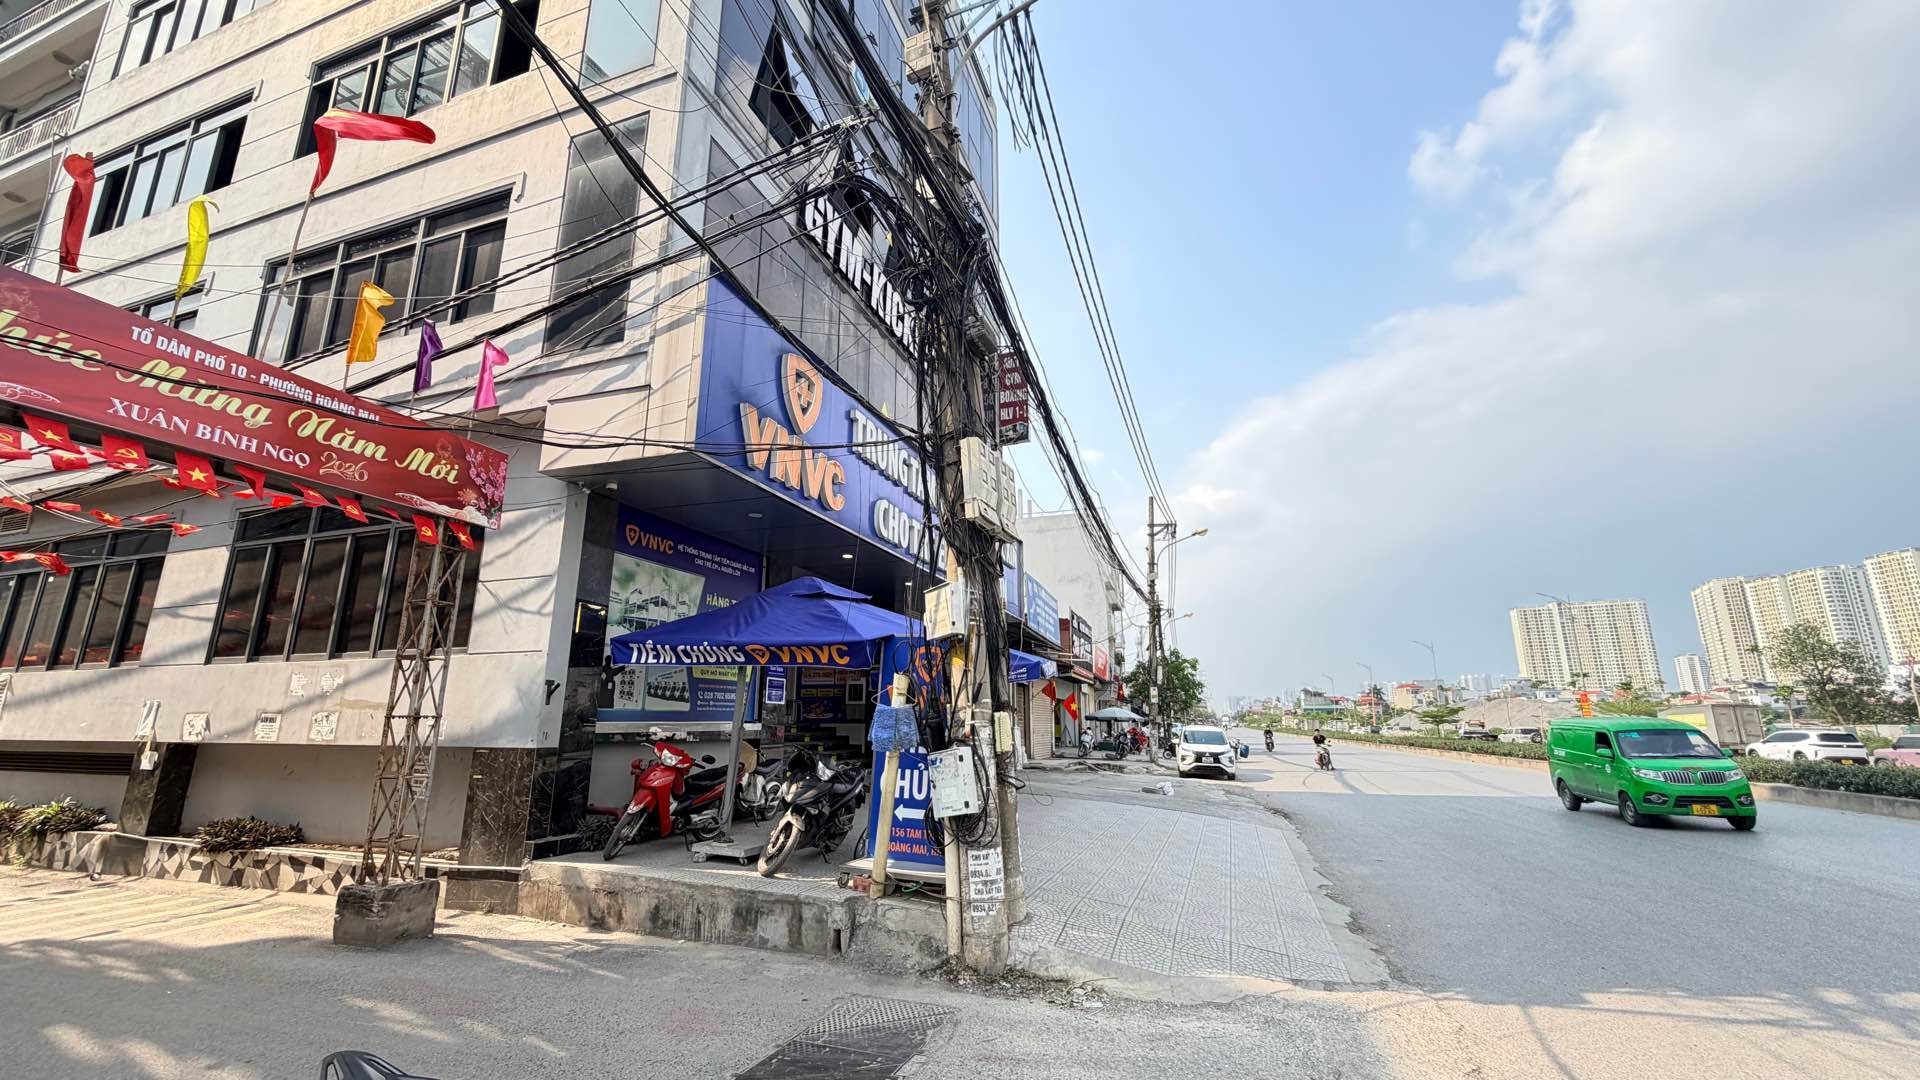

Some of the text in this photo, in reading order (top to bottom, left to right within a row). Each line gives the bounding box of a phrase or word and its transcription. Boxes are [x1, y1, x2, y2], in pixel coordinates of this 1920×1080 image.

[131, 326, 153, 345] TỔ
[156, 335, 192, 360] DÂN
[194, 350, 227, 371] PHỐ
[230, 362, 248, 379] 10
[260, 371, 313, 403] PHƯỜNG
[315, 393, 356, 415] HOÀNG
[358, 408, 381, 422] MAI
[1005, 372, 1022, 386] GYM
[1000, 388, 1027, 404] BOXING
[1000, 406, 1014, 420] HLV
[107, 397, 369, 482] XUÂN BÍNH NGỌ 2026
[115, 358, 273, 429] Mừng
[287, 408, 389, 462] Năm
[394, 447, 460, 484] Mới
[740, 402, 846, 512] VNVC
[850, 408, 909, 487] TRUNG
[640, 531, 675, 554] VNVC
[873, 499, 909, 549] CHO
[629, 640, 850, 665] TIÊM CHỦNG VNVC
[880, 763, 933, 800] HỦ
[891, 827, 905, 837] 156
[906, 828, 921, 839] TAM
